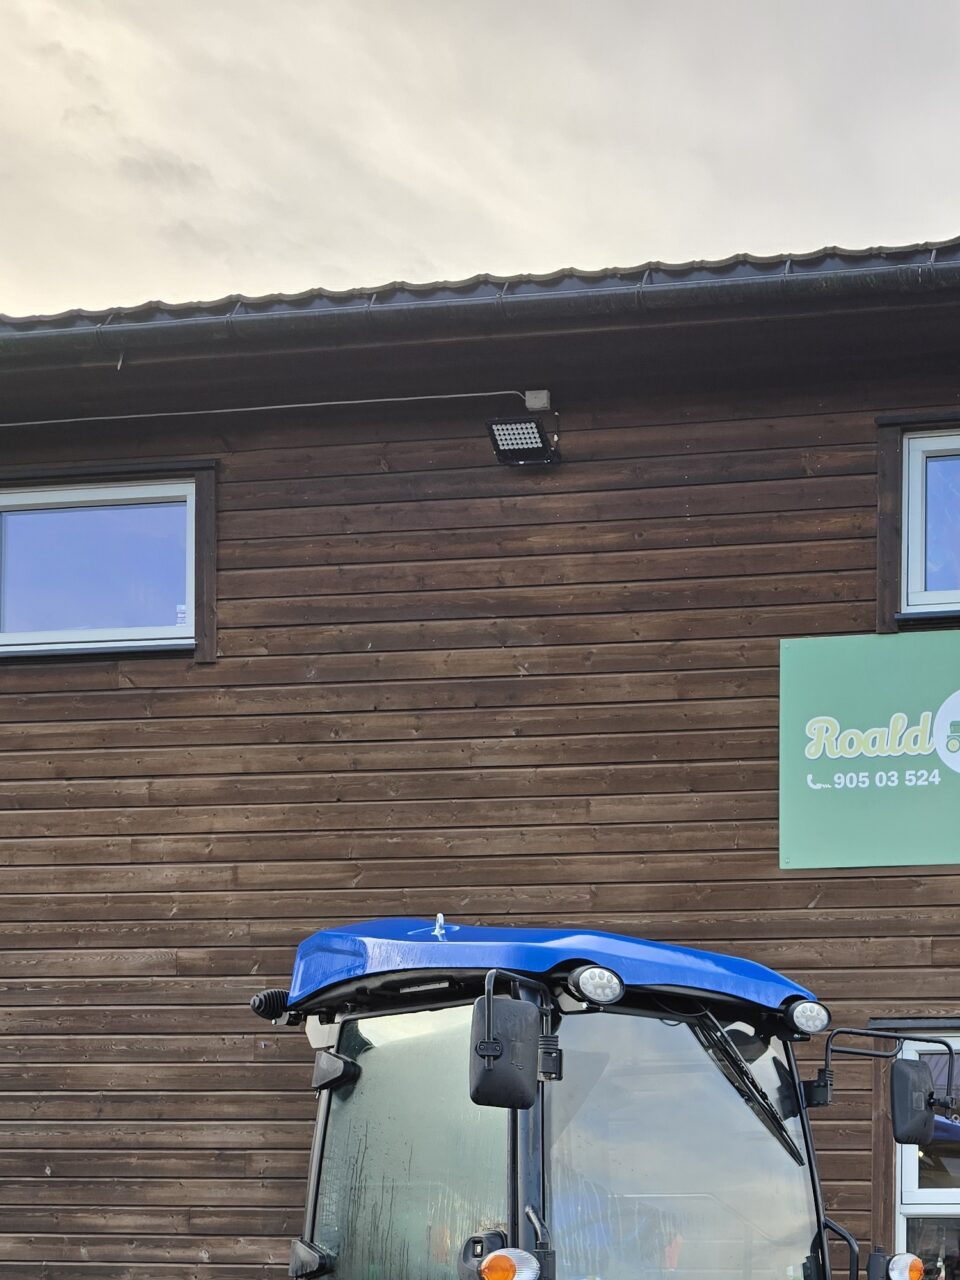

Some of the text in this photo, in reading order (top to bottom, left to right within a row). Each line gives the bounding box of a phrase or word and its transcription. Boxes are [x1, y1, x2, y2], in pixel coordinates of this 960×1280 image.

[805, 711, 937, 760] Roald
[833, 769, 941, 789] 905 03 524
